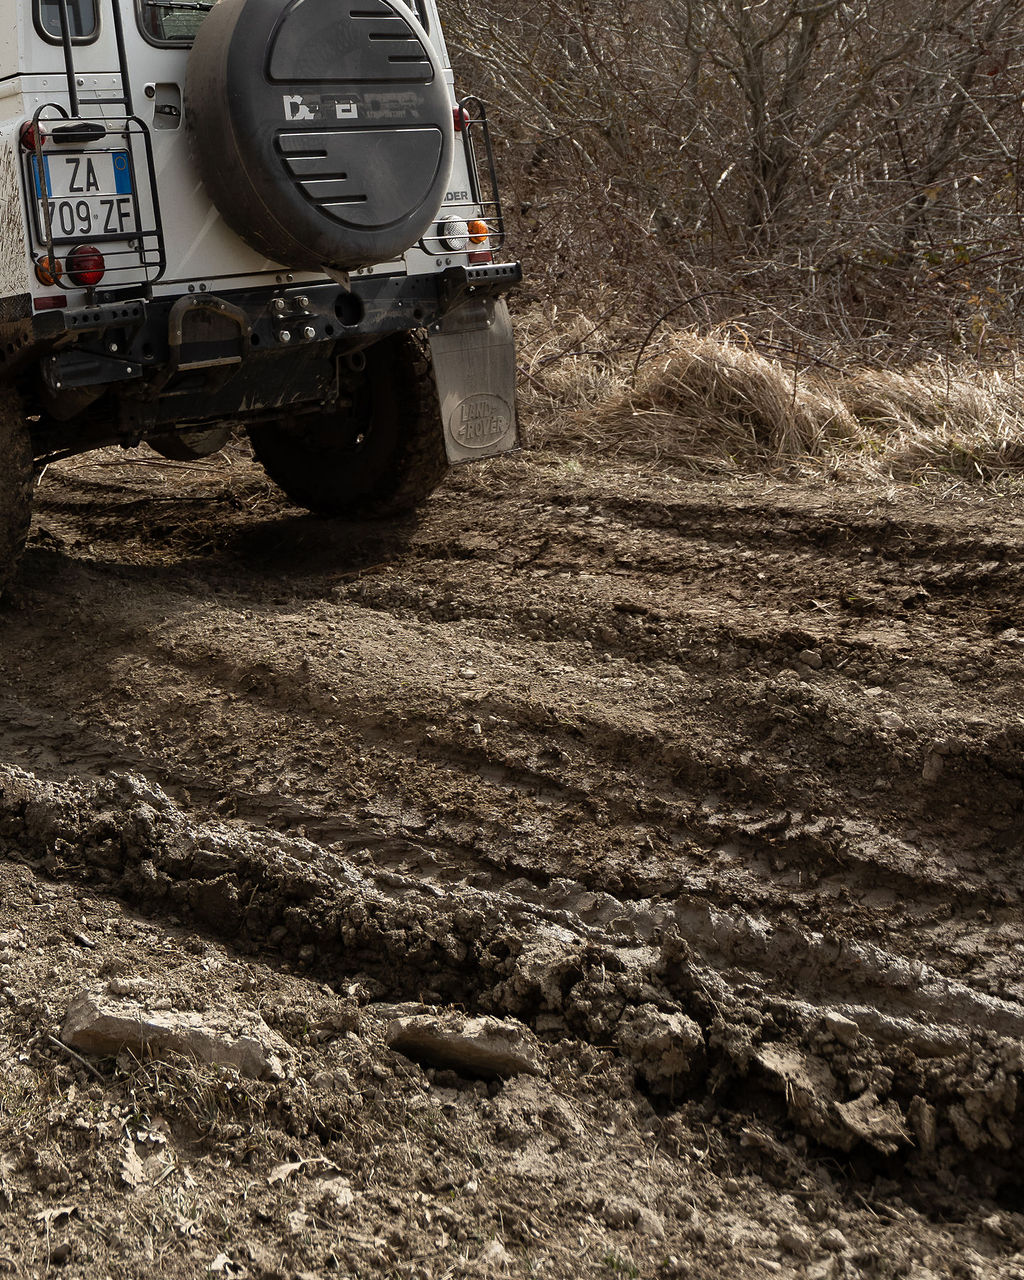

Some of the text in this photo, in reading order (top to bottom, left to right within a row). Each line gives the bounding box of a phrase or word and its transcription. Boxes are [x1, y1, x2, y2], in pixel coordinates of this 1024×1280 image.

[65, 157, 99, 193] ZA
[100, 197, 131, 234] ZF
[460, 401, 492, 422] LAND
[465, 415, 505, 439] ROVER
